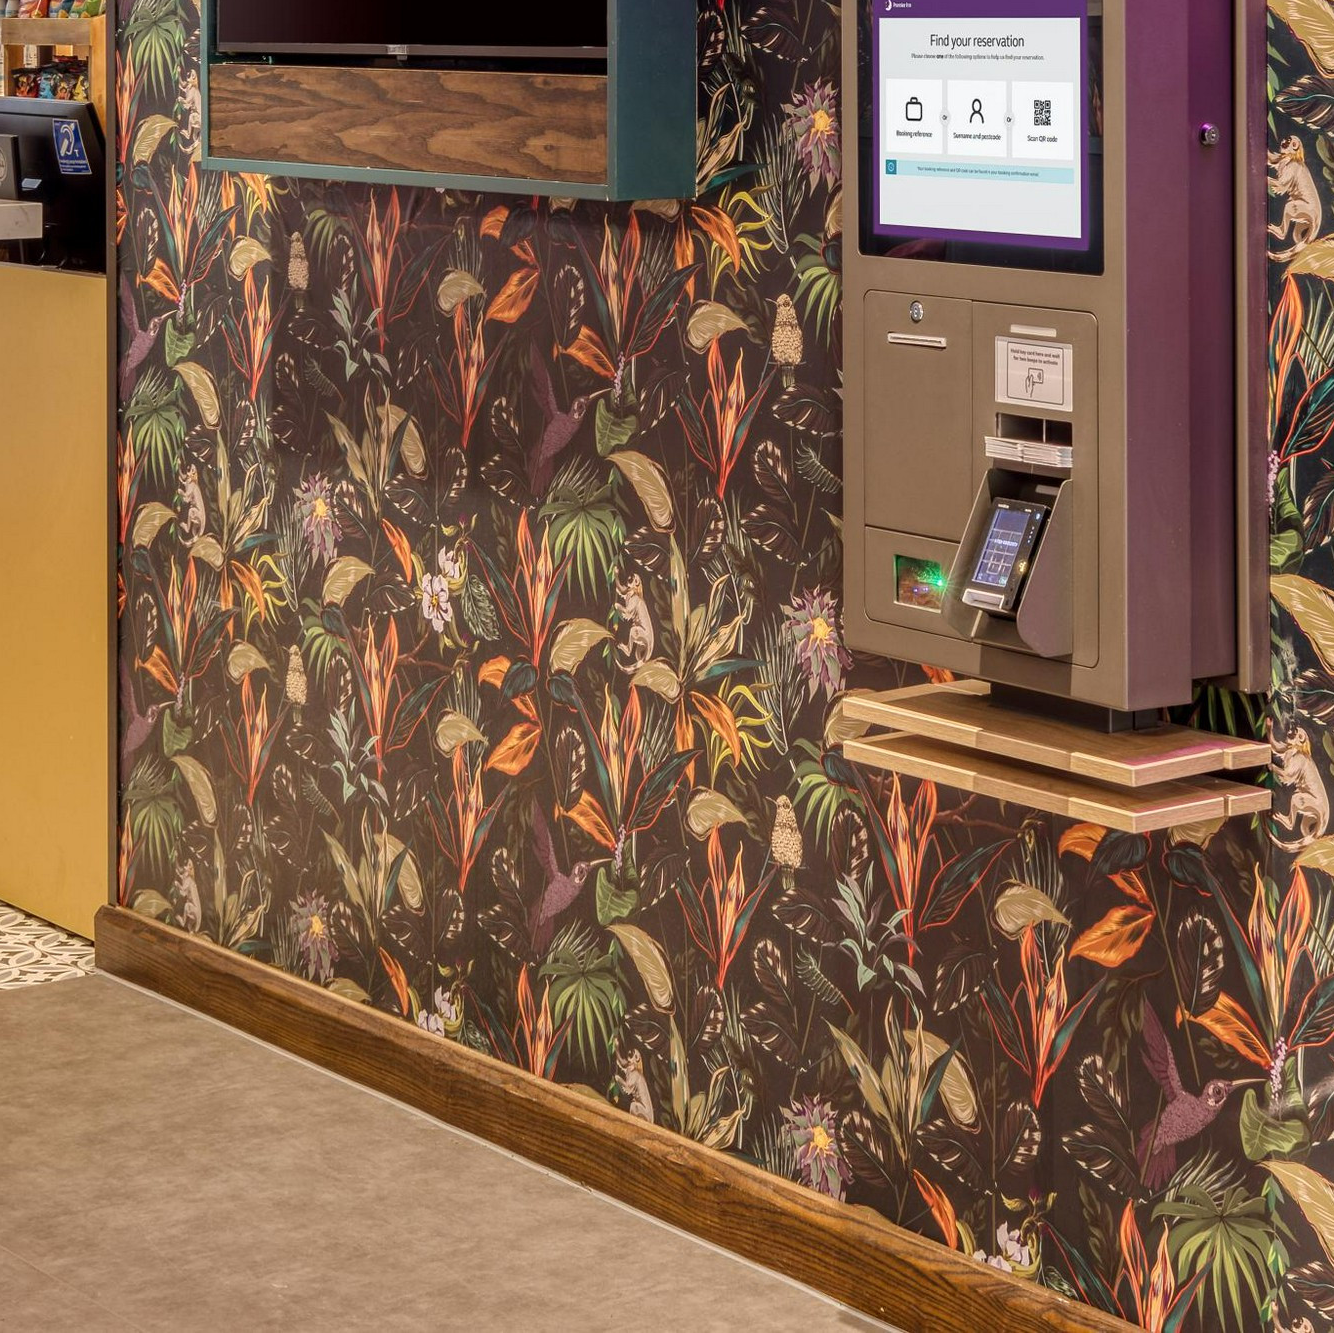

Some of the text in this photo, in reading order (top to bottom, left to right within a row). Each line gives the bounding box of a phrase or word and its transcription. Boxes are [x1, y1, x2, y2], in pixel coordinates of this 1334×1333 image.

[930, 34, 1024, 50] Find your reservation
